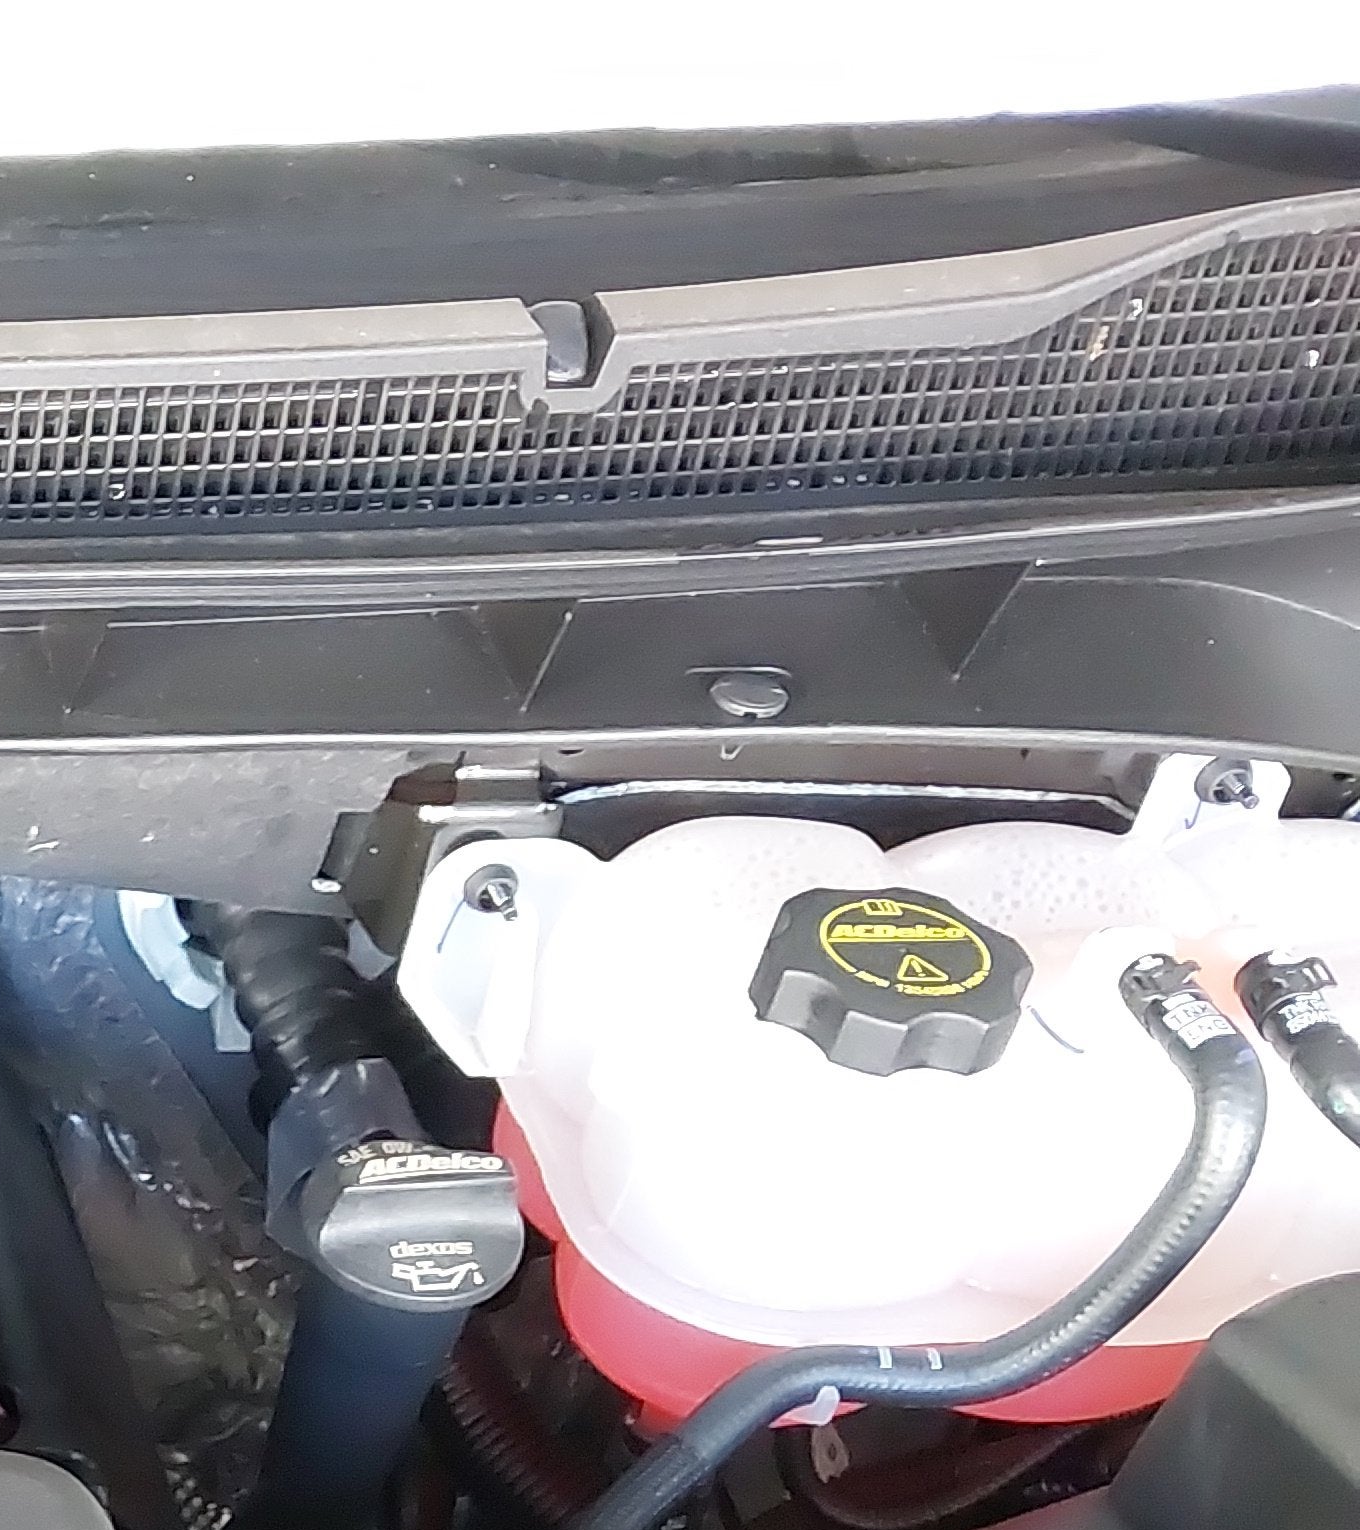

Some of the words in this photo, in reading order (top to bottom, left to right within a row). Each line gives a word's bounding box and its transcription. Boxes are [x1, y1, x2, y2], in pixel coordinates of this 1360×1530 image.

[830, 924, 967, 939] ACDelco
[359, 1152, 503, 1179] ACDelco
[389, 1240, 473, 1259] dexos
